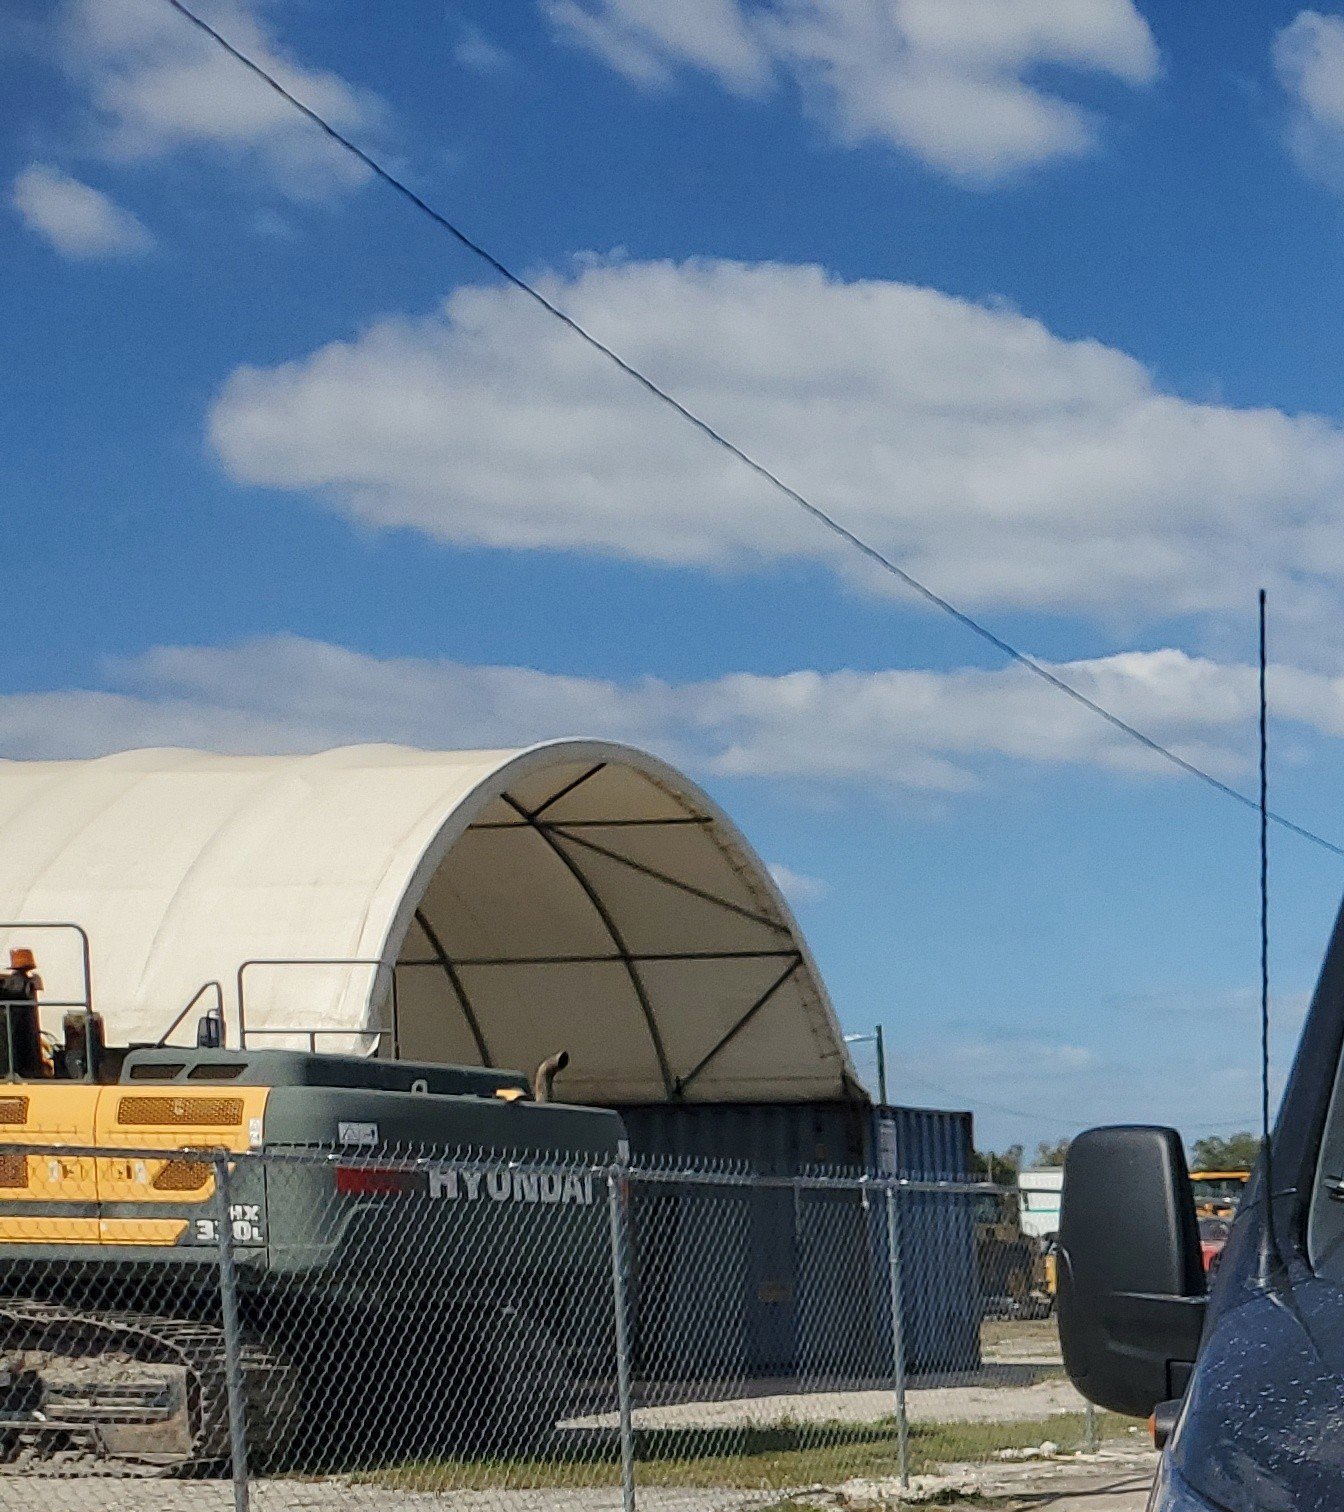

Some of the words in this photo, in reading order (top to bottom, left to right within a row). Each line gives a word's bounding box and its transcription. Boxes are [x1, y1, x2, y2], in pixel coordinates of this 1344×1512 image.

[428, 1167, 594, 1205] HYUNDAI
[230, 1203, 260, 1221] HX
[196, 1219, 264, 1241] 30L
